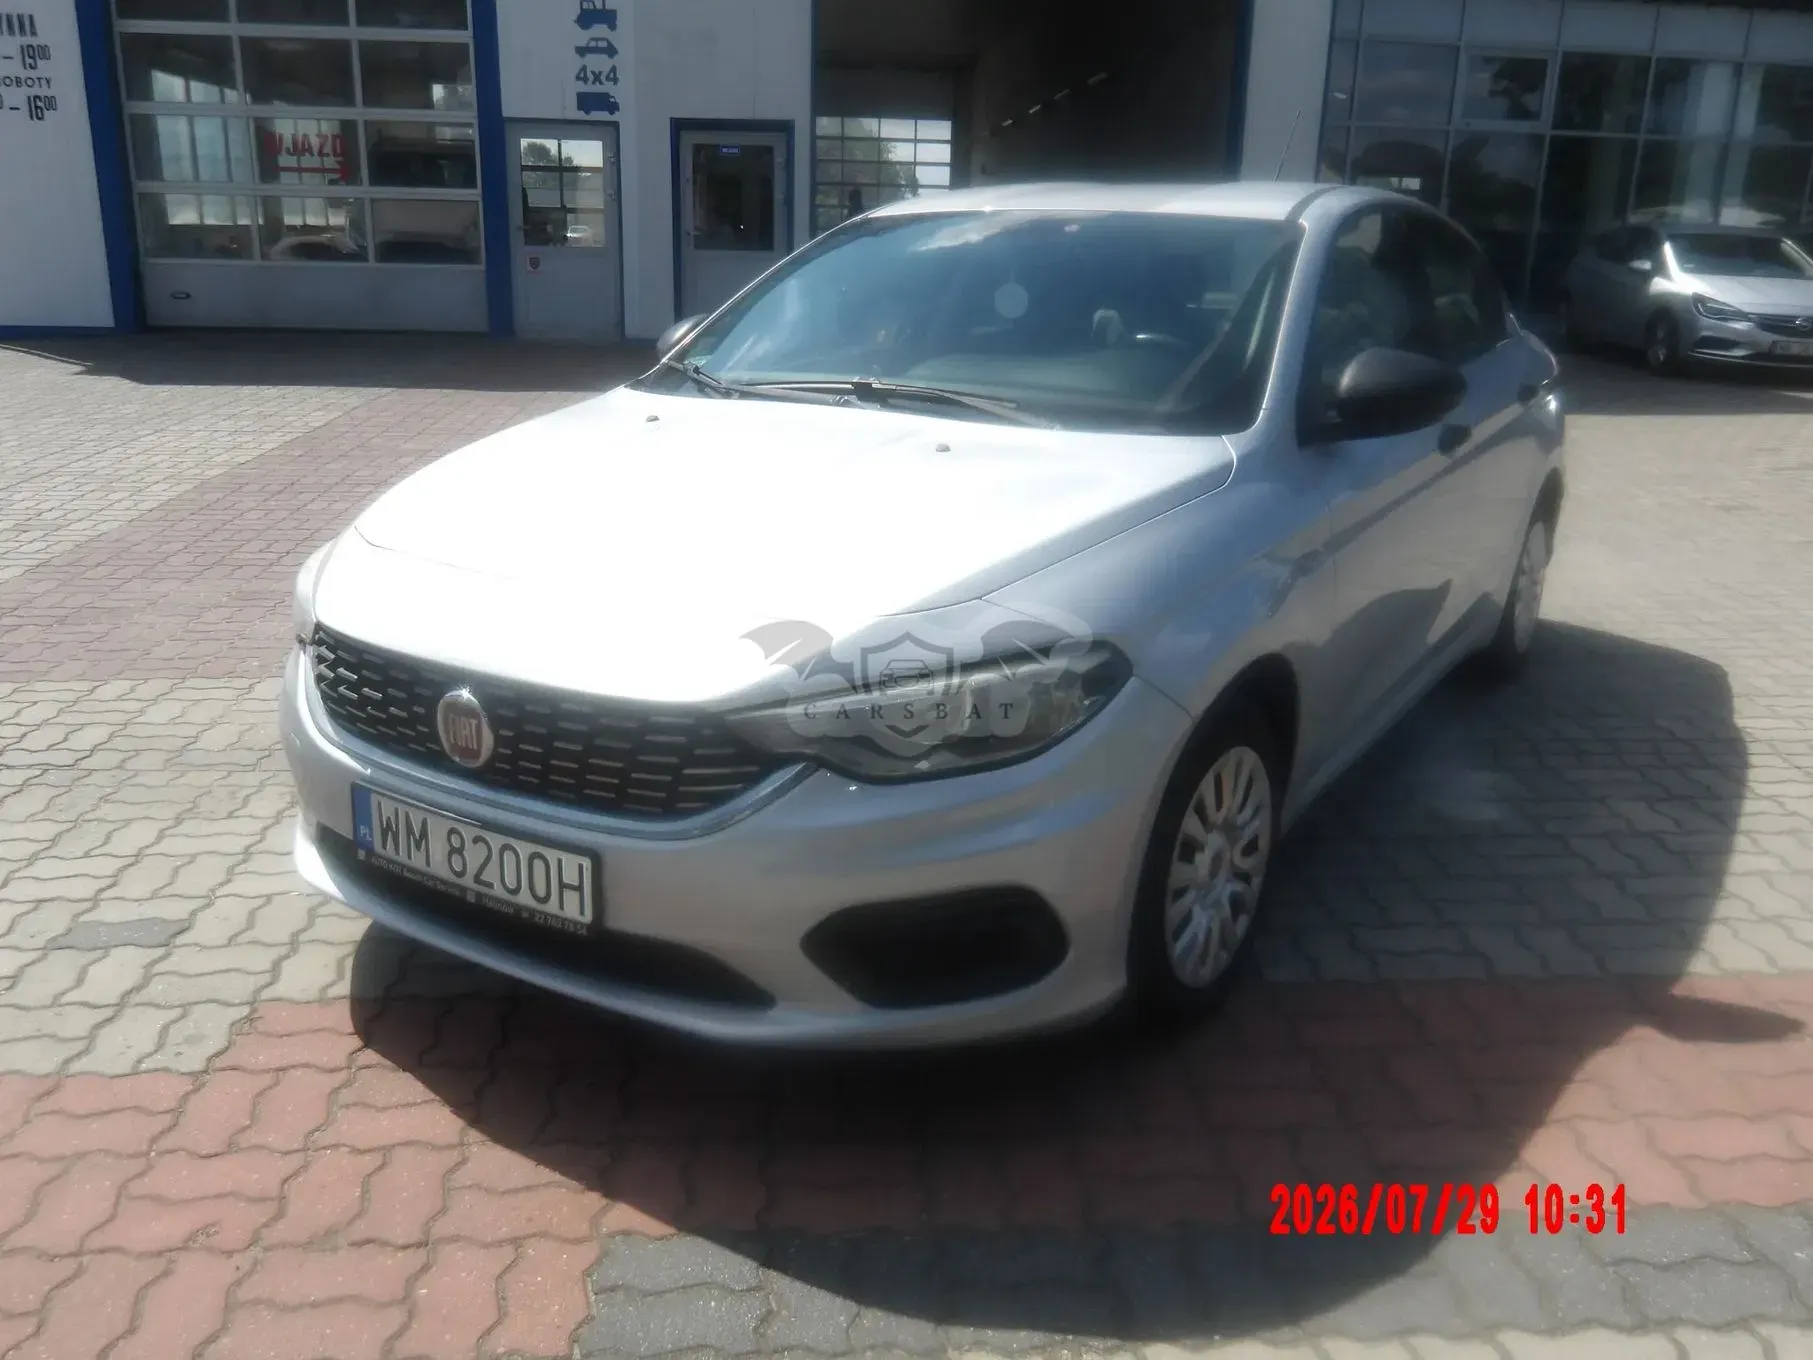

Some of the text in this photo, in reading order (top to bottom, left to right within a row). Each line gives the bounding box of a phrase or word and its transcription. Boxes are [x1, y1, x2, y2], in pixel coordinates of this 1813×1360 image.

[0, 75, 51, 88] OBOTY
[575, 64, 619, 86] 4x4
[360, 824, 372, 841] PL
[377, 800, 432, 868] WM
[446, 826, 586, 917] 8200H
